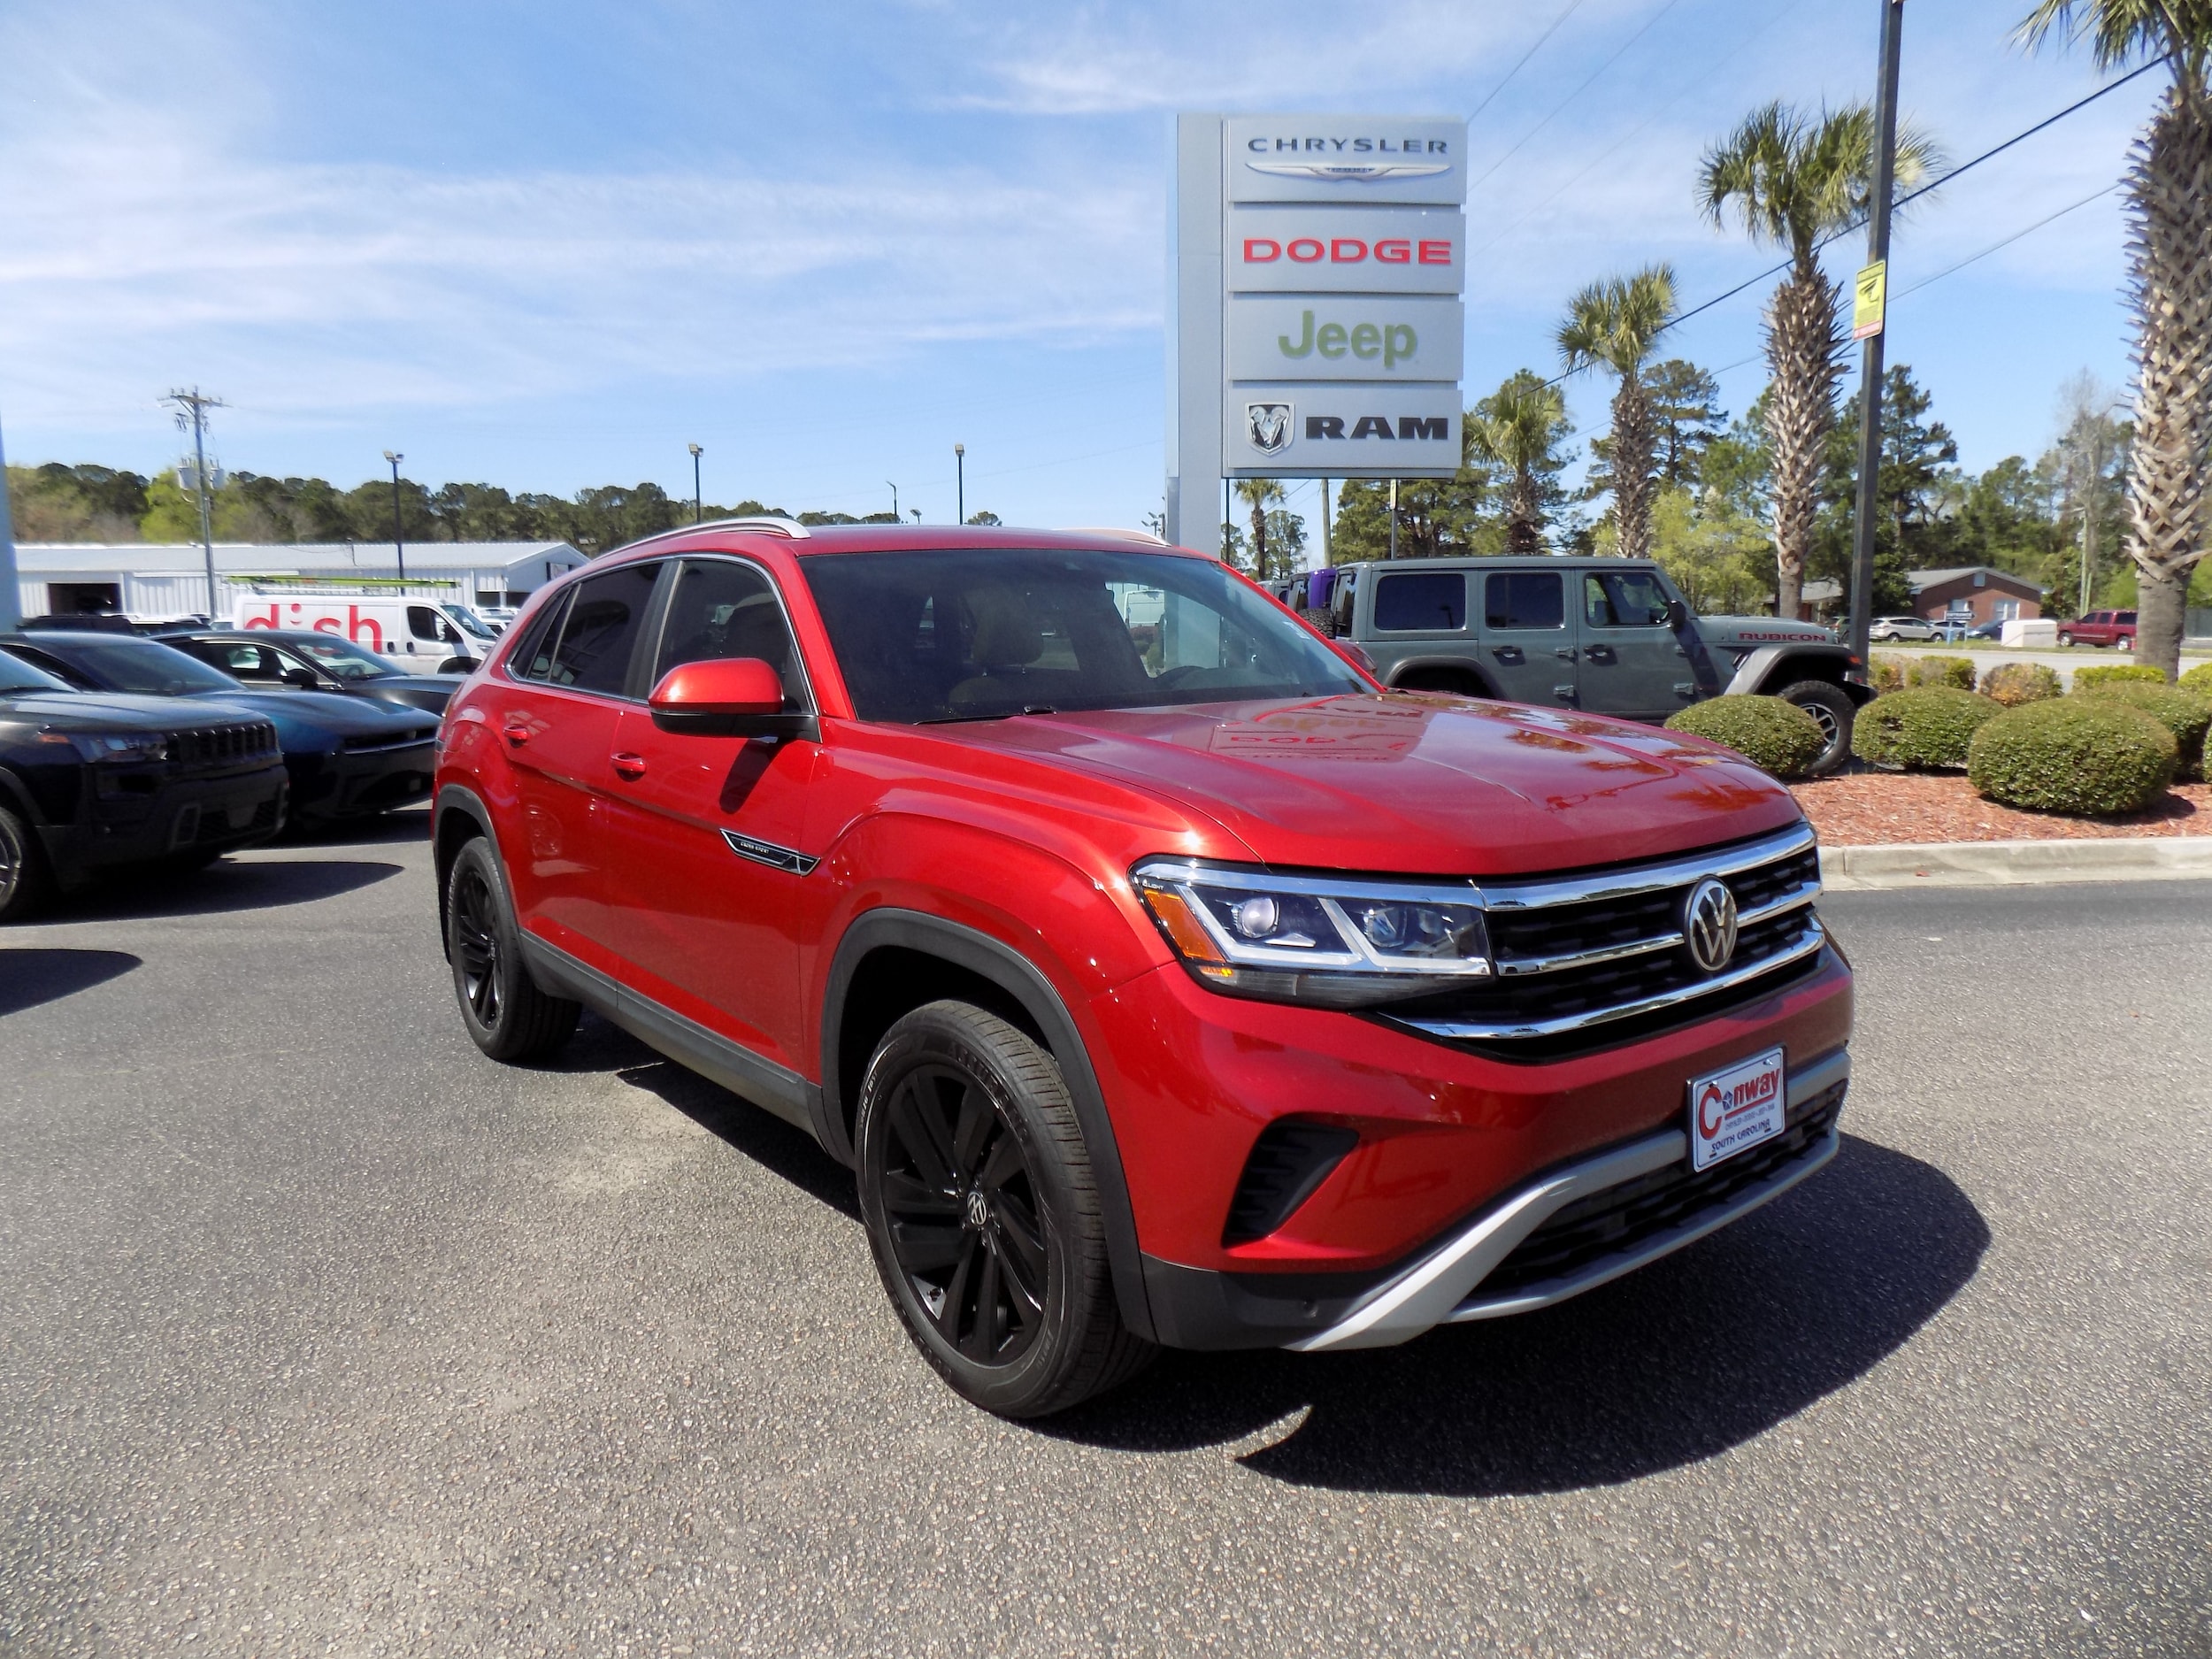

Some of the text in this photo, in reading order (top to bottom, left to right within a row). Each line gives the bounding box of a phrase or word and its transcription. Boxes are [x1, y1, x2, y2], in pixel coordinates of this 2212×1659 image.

[1247, 137, 1448, 156] CHRYSLER
[1242, 238, 1452, 265] DODGE
[1278, 310, 1418, 369] Jeep
[1305, 416, 1449, 441] RAM
[1738, 632, 1827, 642] RUBICON
[1710, 1118, 1770, 1153] SOUTH CAROLINA
